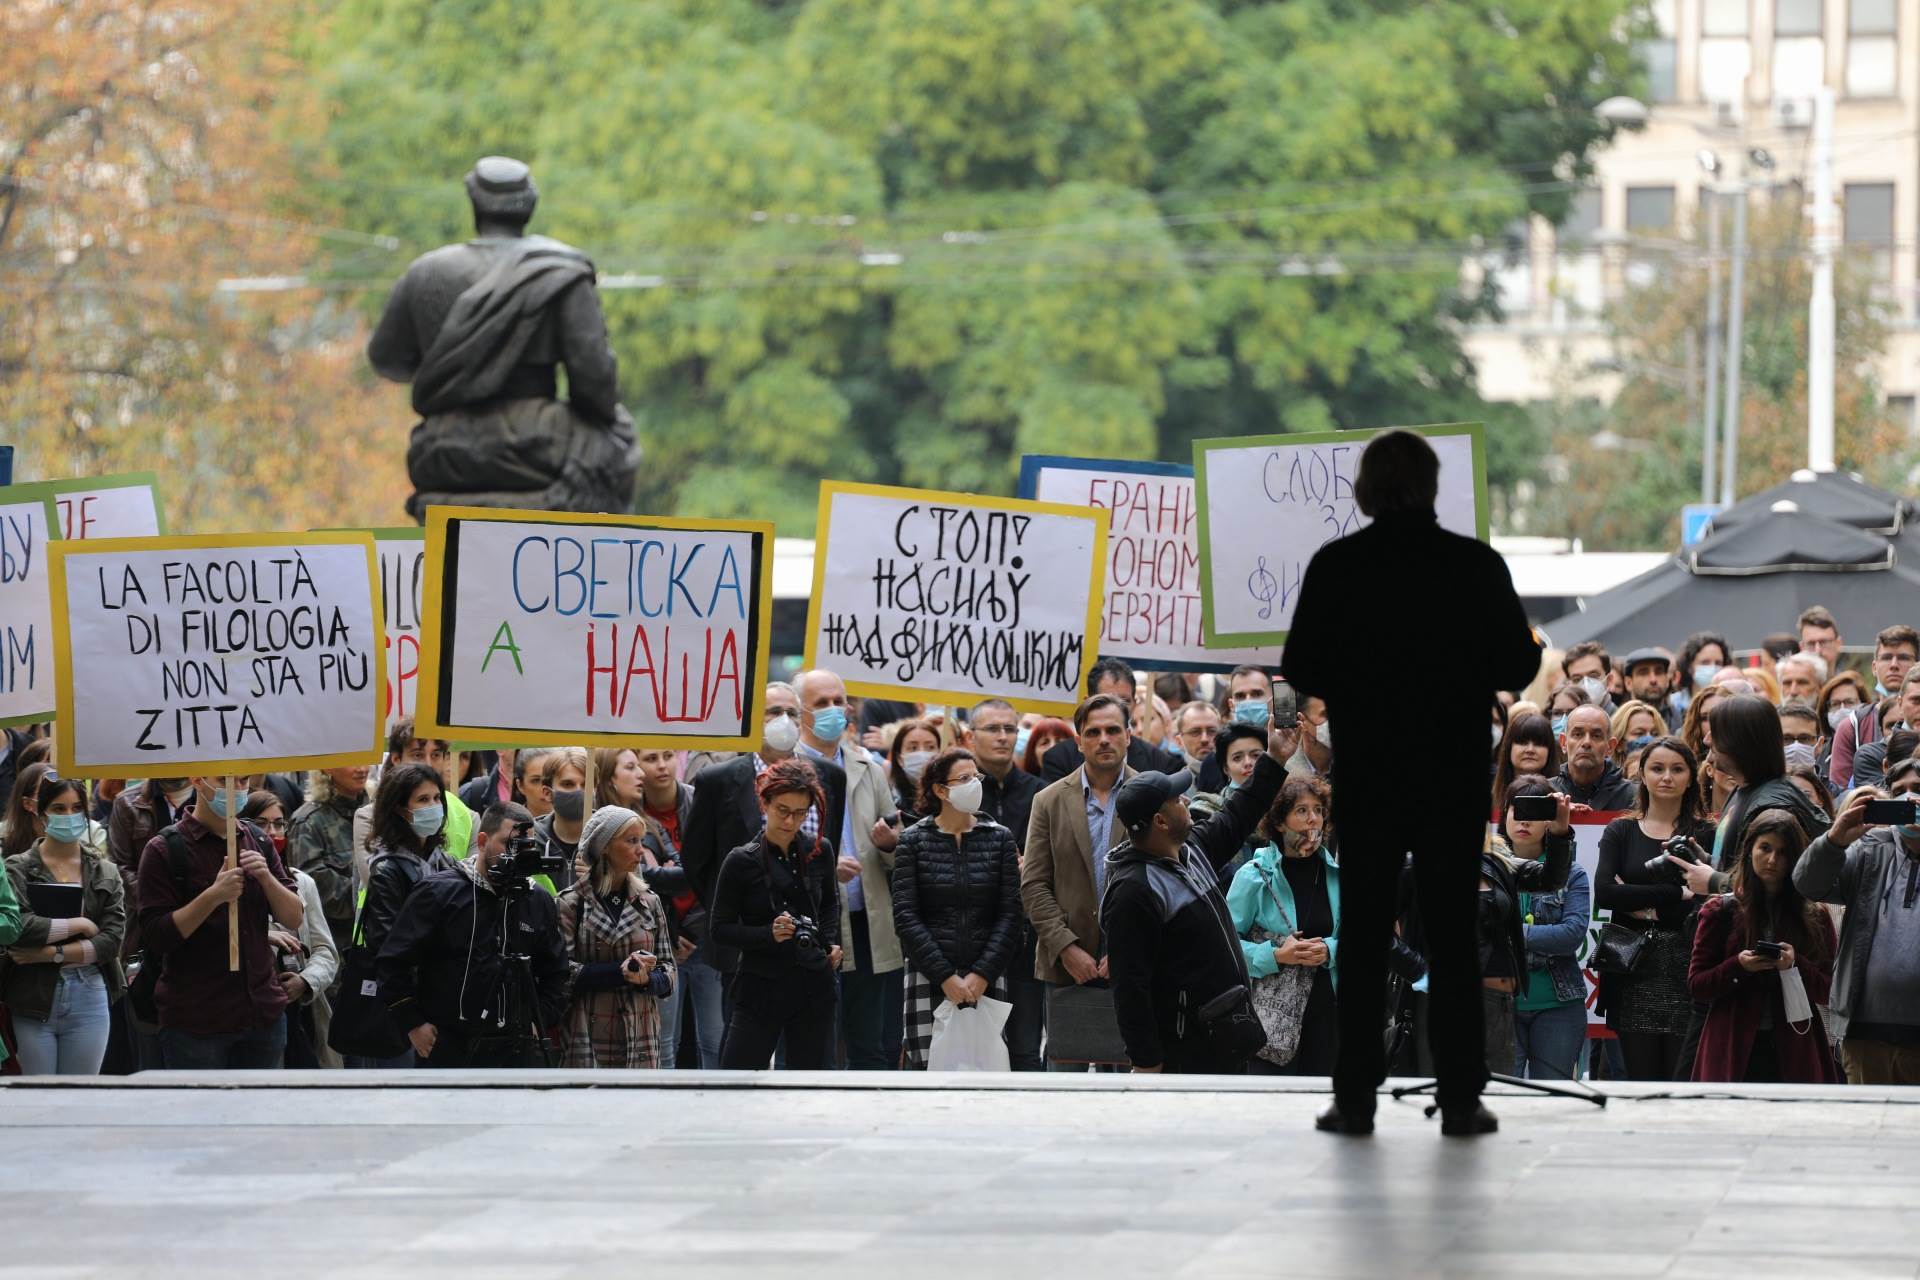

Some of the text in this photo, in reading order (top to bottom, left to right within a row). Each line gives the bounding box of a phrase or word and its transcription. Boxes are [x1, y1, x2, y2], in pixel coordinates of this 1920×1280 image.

[1264, 445, 1362, 504] СЛОБ
[895, 505, 1031, 569] СТОП!
[1108, 534, 1200, 591] ОНОМ
[98, 549, 318, 609] LA FACOLTÀ
[513, 536, 746, 618] СВЕТСКА
[873, 558, 1030, 629] НАСИЉУ
[126, 606, 351, 654] DI FILOLOGIA
[1099, 591, 1205, 647] ЕРЗИТ
[162, 647, 369, 700] NON STA PIÙ
[481, 620, 743, 722] А НАША
[824, 613, 1083, 692] НАД ФИЛОЛОШКИМ
[135, 705, 264, 750] ZITTA
